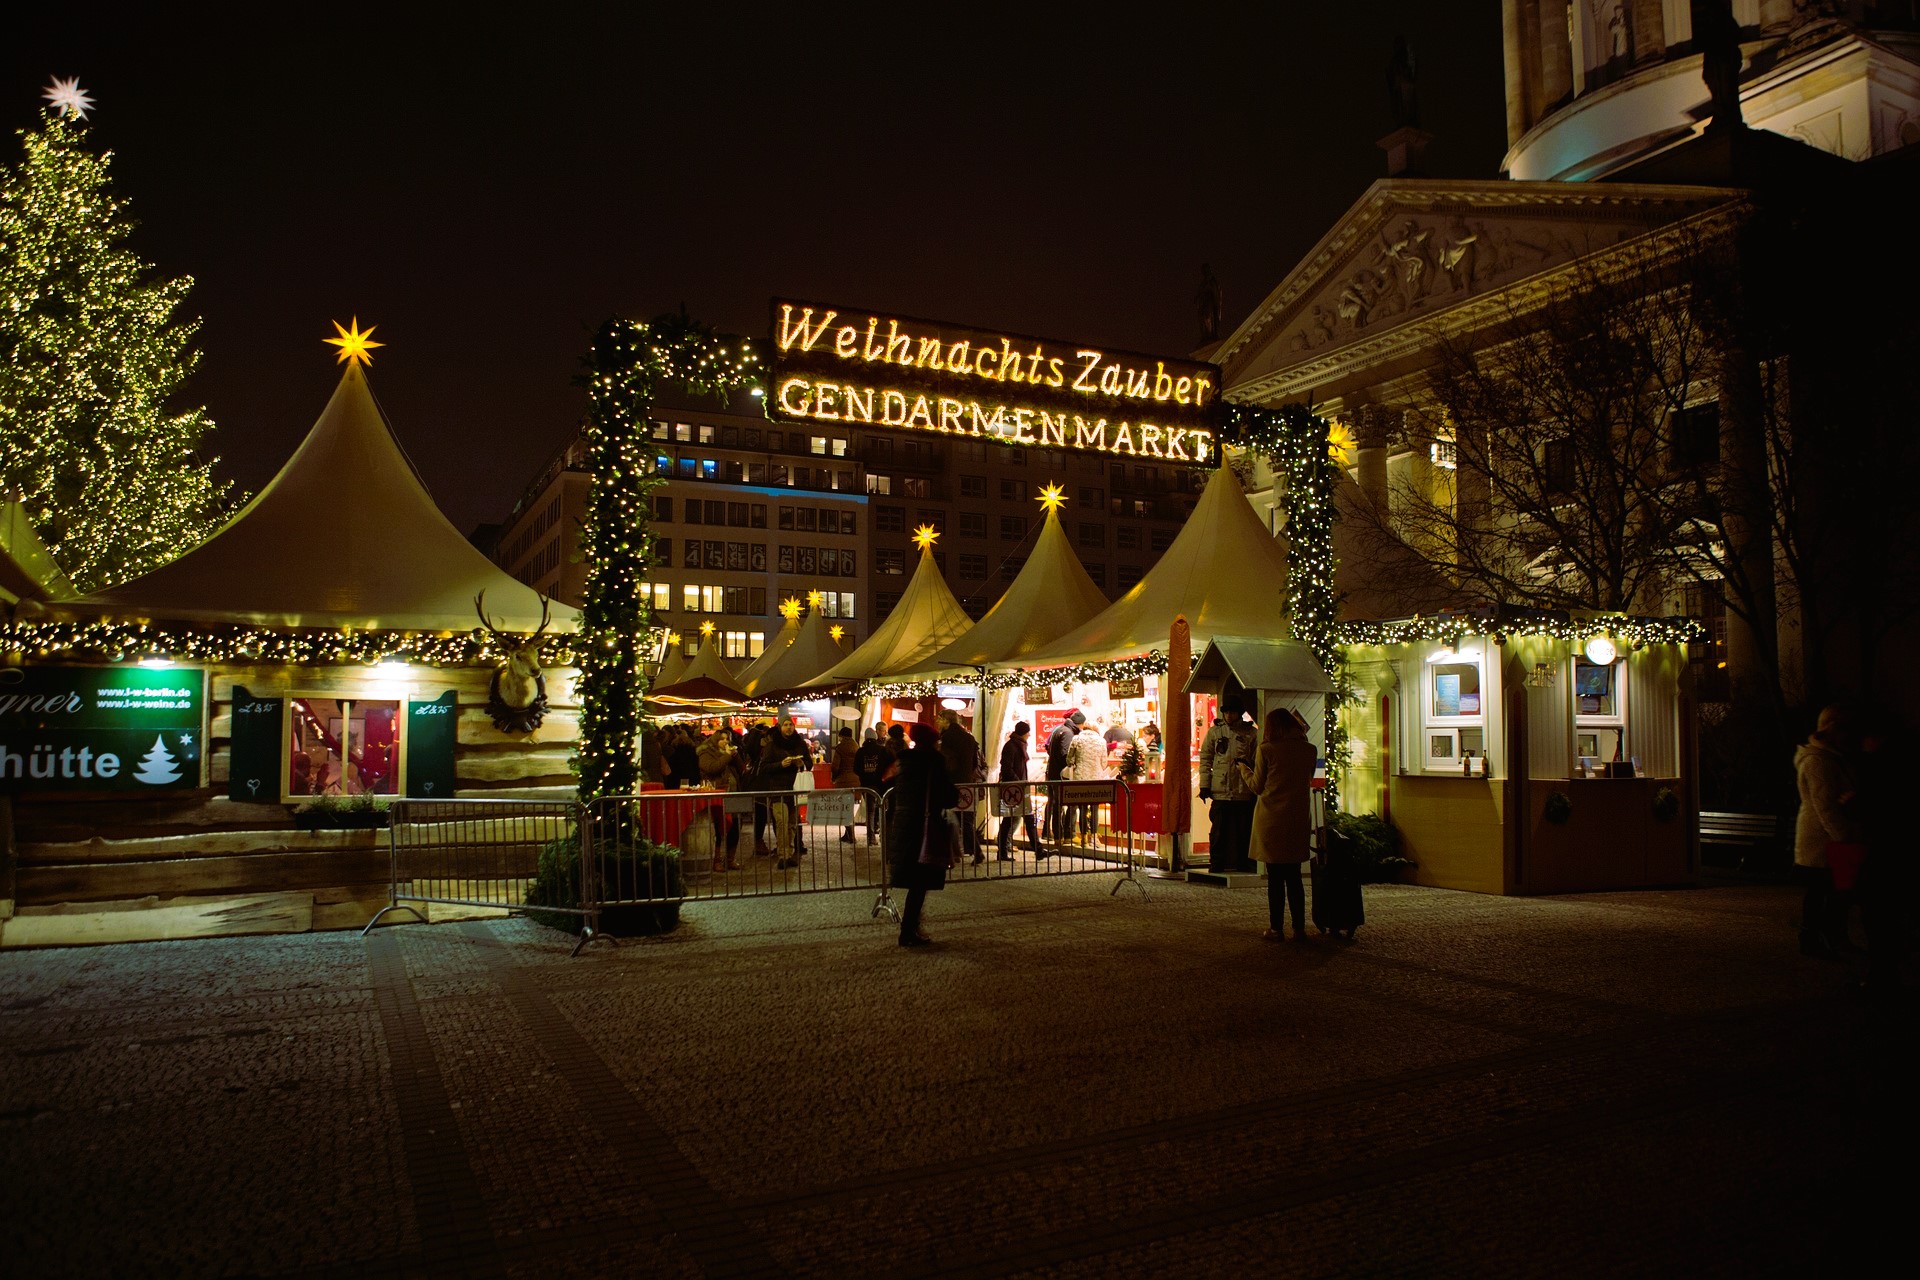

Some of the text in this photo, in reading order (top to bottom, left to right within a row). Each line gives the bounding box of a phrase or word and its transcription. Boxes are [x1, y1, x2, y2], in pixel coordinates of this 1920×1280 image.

[780, 304, 1211, 407] Weihnachts Zauber
[780, 378, 1213, 464] GENDARMENMARKT
[0, 745, 120, 778] hütte
[821, 794, 843, 802] Kasse
[1064, 790, 1112, 798] Feuerwehrzufahrt
[812, 803, 840, 811] Tickets
